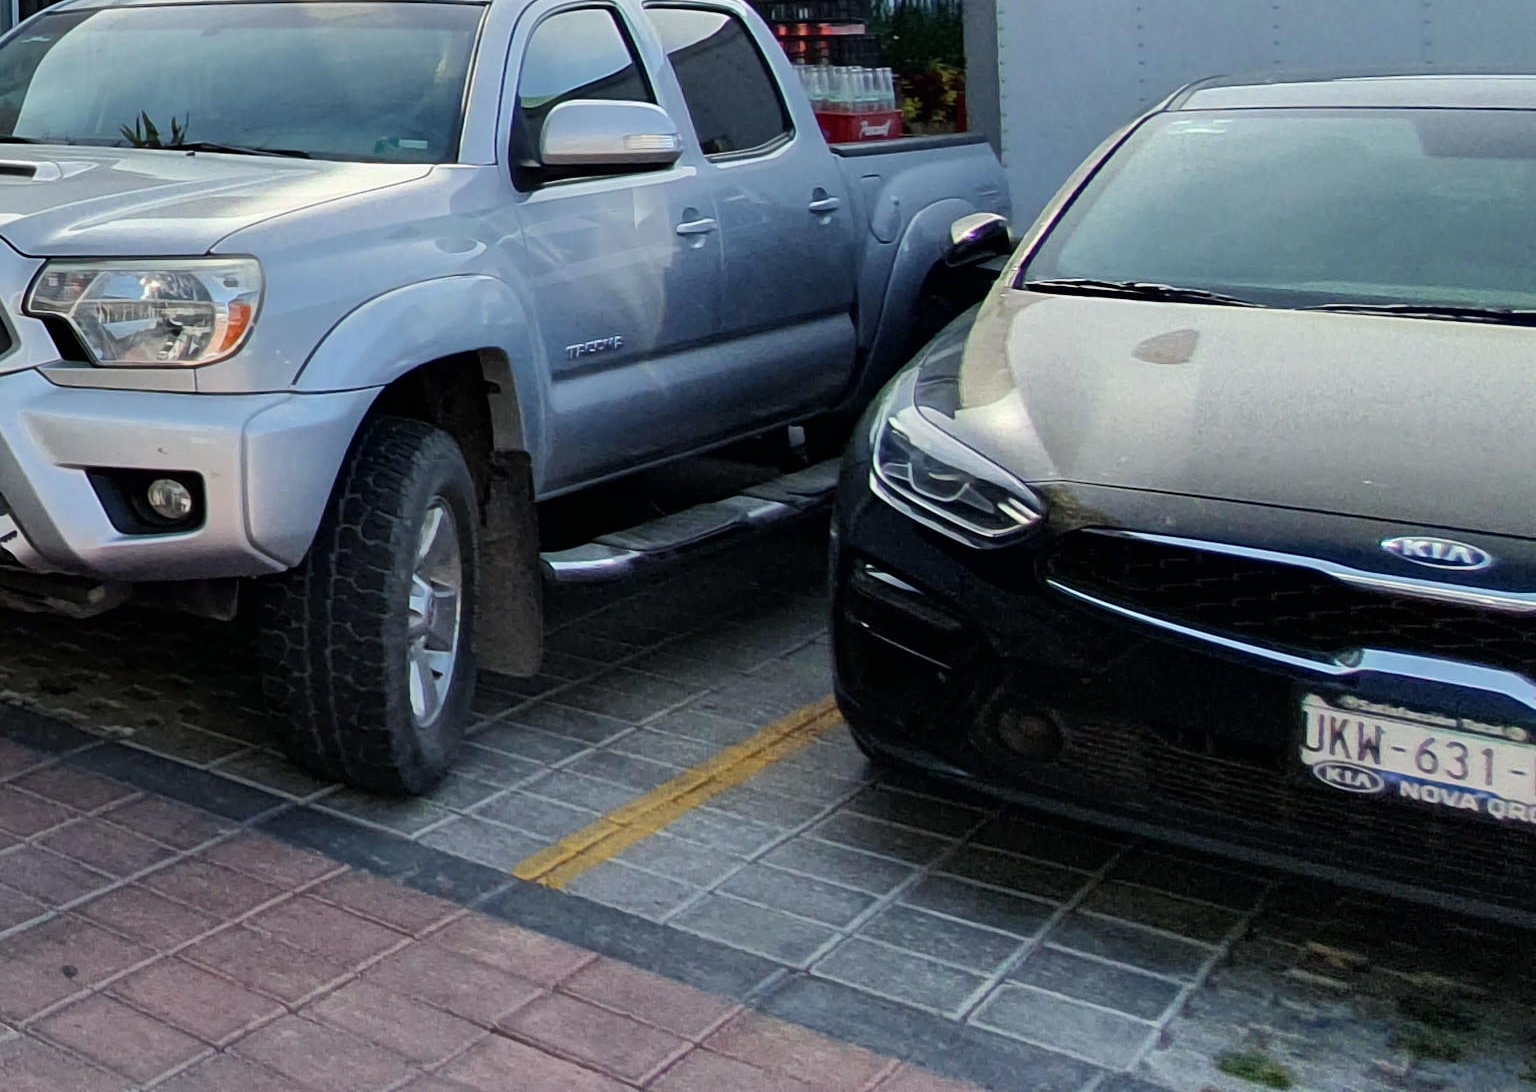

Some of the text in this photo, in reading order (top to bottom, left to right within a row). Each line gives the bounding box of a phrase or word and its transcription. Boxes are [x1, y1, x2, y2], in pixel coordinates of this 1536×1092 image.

[1403, 539, 1474, 565] KIA
[1328, 766, 1374, 788] KIA
[1399, 780, 1479, 812] NOVA
